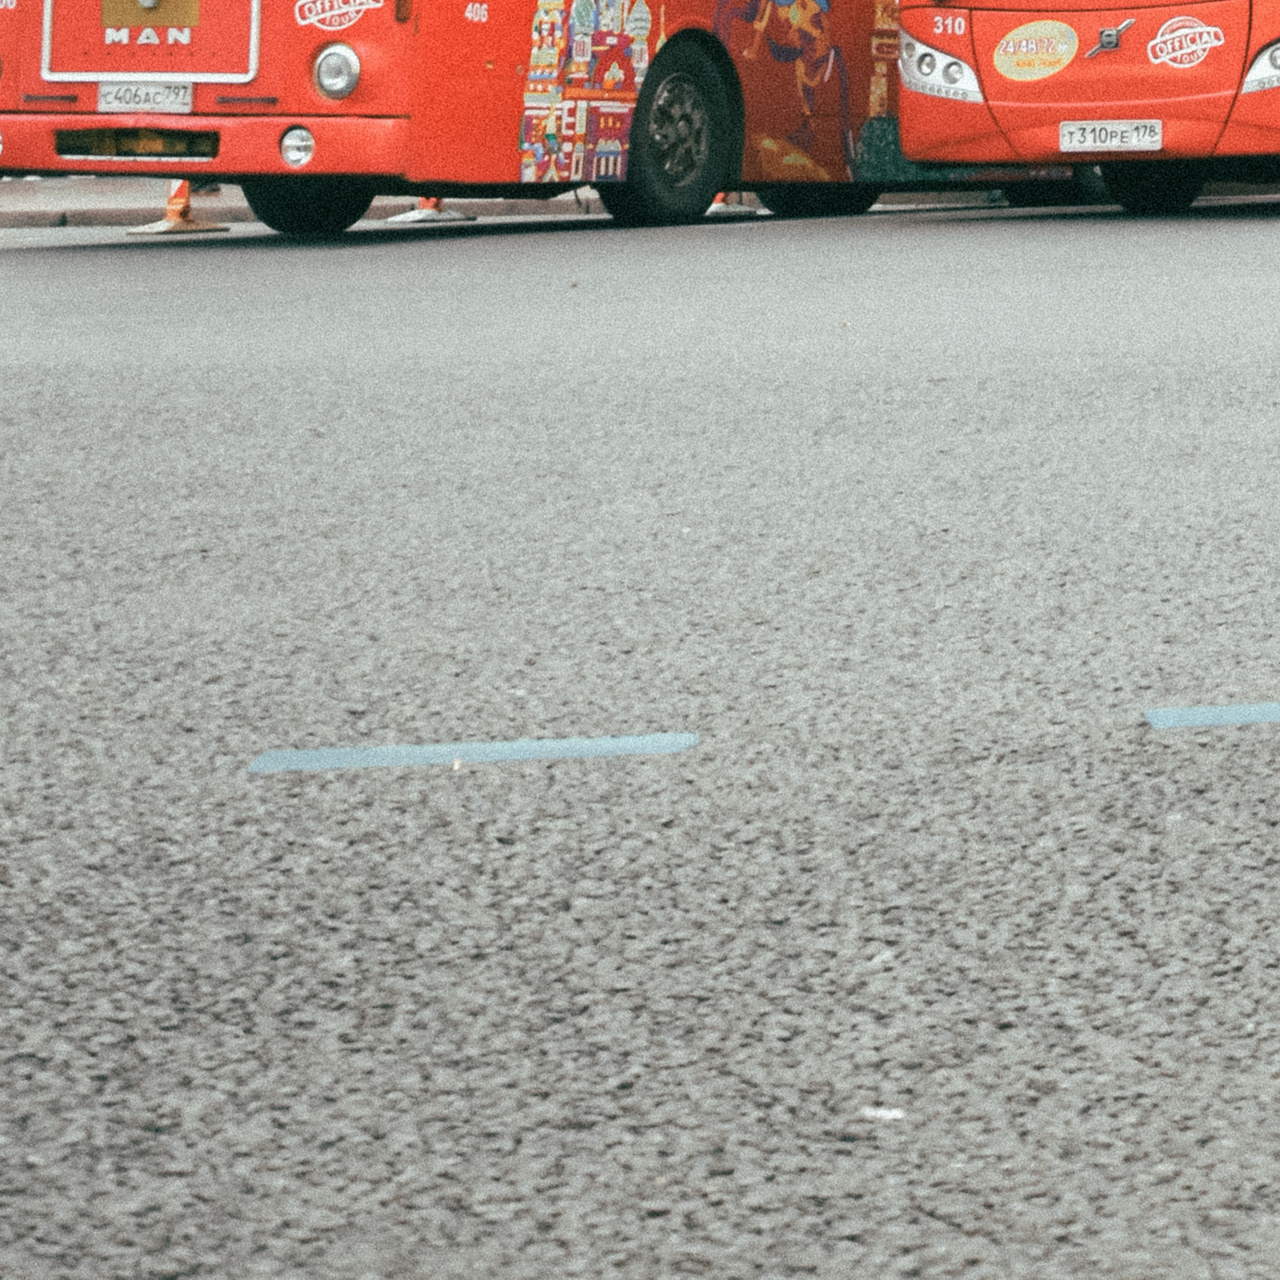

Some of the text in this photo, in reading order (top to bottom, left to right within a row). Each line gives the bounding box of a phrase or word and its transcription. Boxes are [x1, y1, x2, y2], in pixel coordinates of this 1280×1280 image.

[326, 10, 361, 25] TOUR
[464, 2, 489, 22] 406
[105, 27, 192, 45] MAN
[933, 16, 966, 36] 310
[1155, 30, 1222, 57] OFFICIAL
